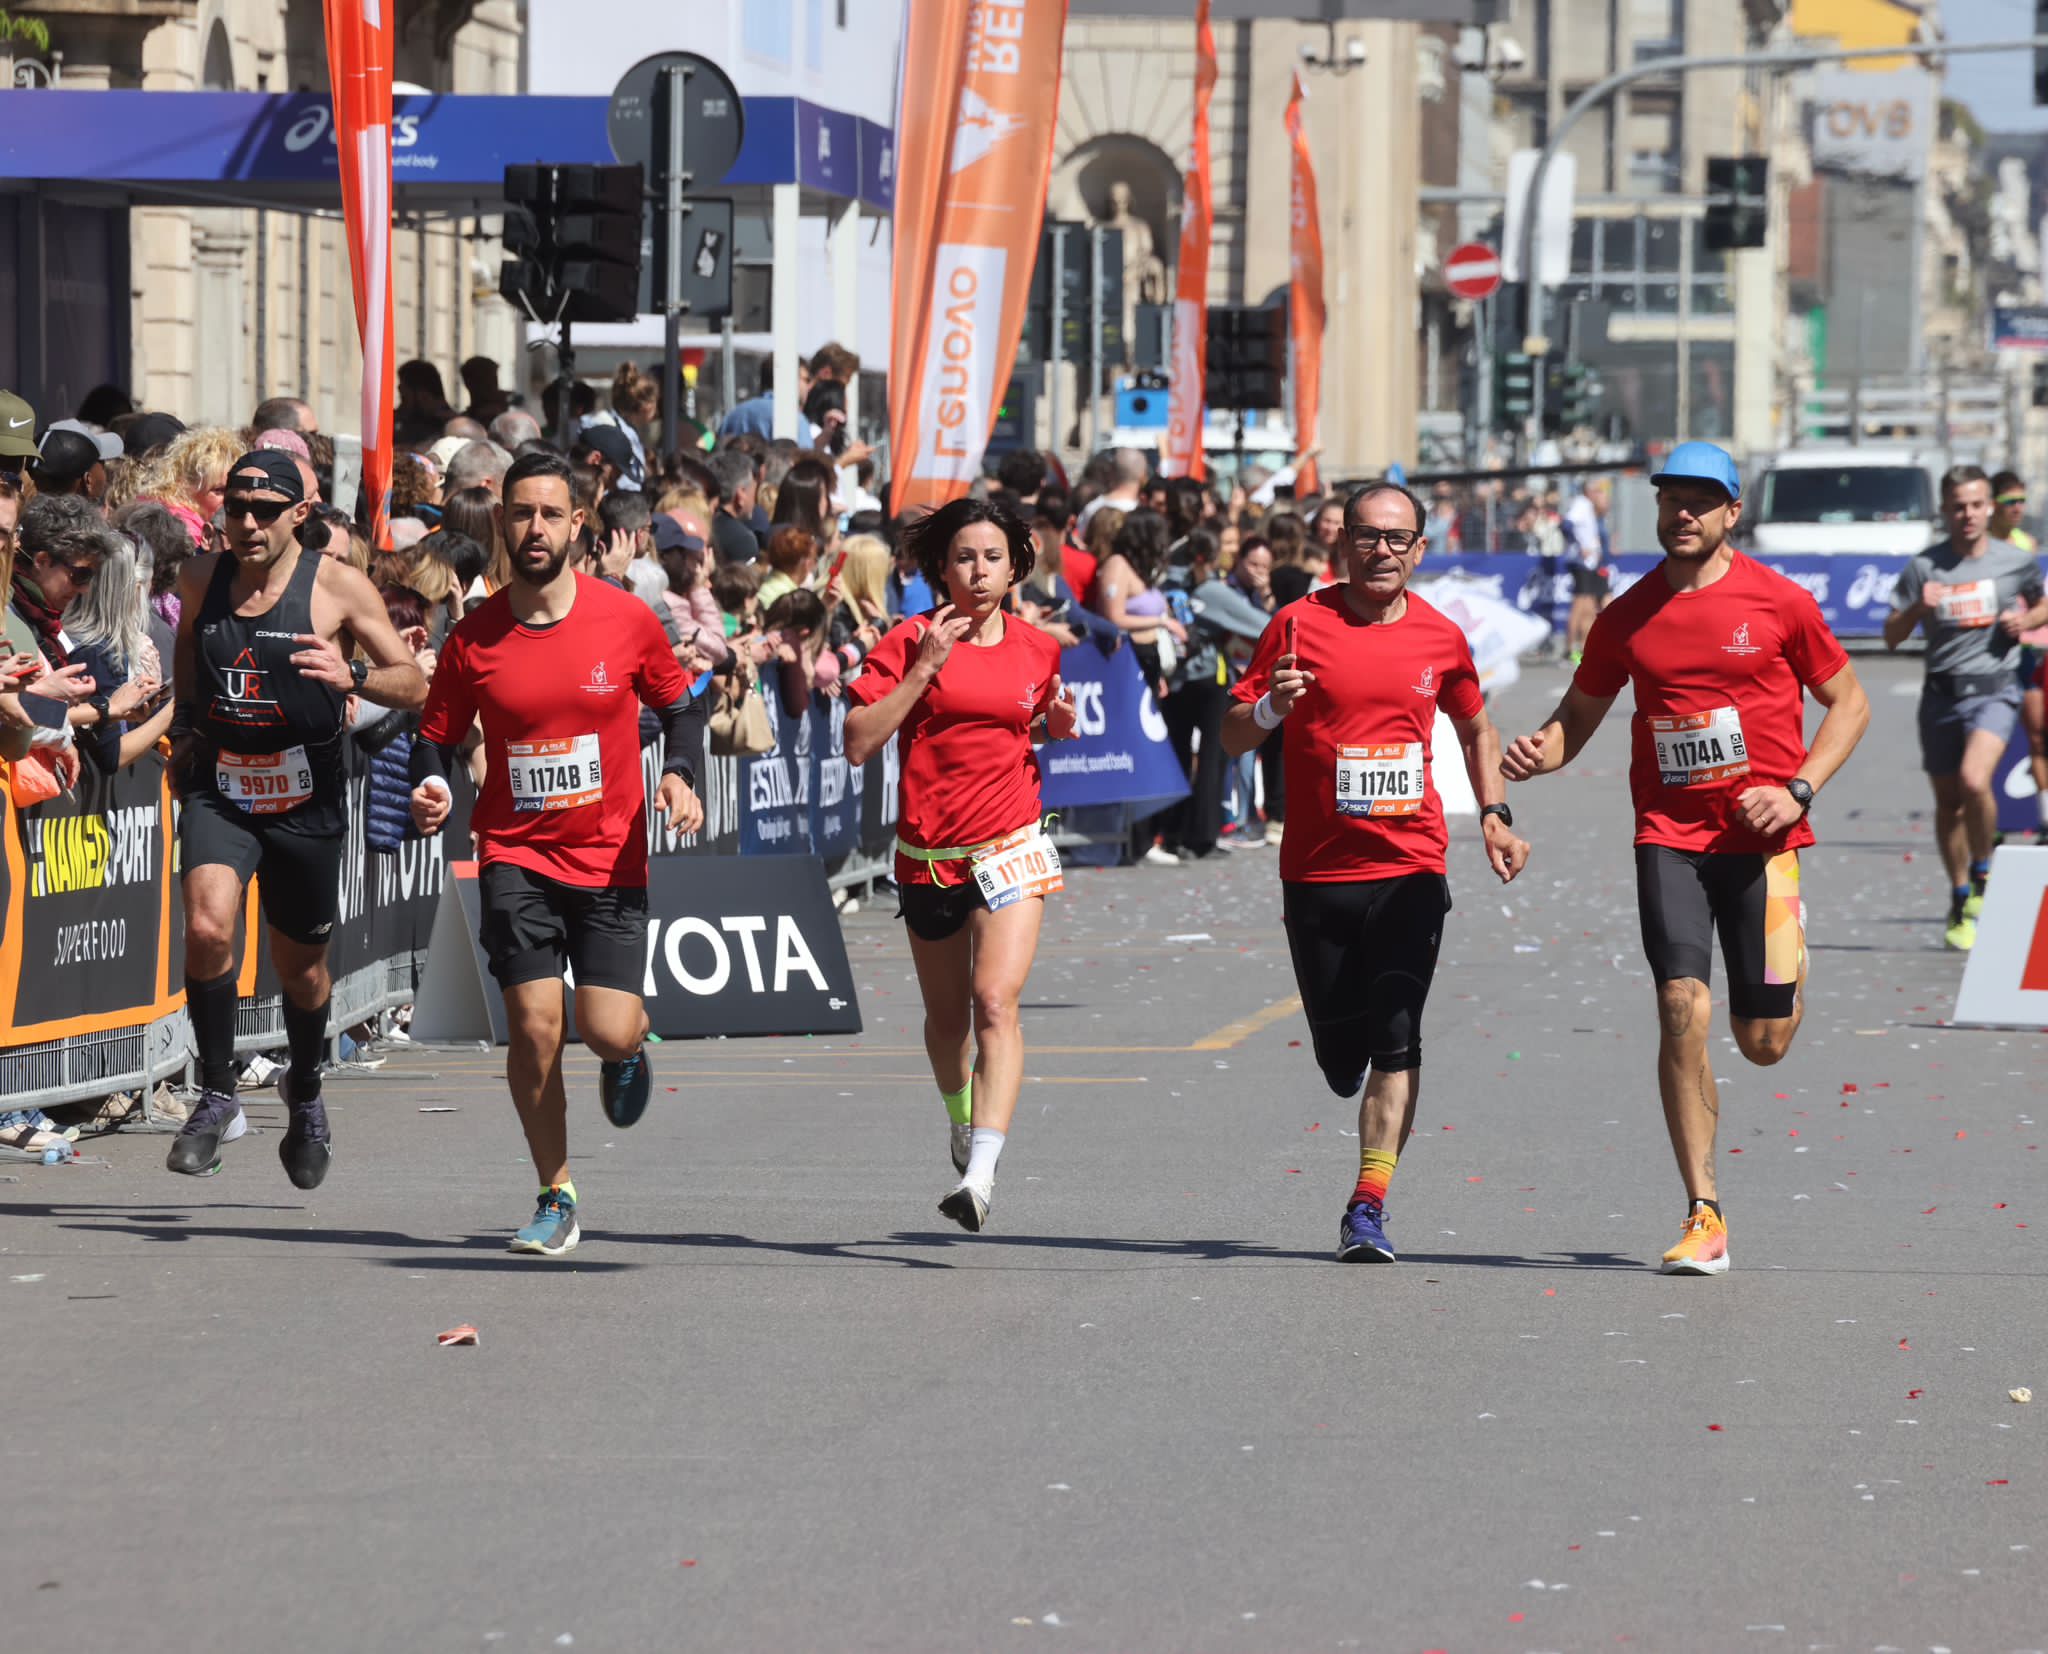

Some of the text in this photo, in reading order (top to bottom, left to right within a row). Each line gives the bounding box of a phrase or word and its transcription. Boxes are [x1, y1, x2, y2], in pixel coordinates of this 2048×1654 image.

[227, 672, 261, 699] UR
[1672, 738, 1724, 767] 1174A
[529, 765, 581, 792] 1174B
[1360, 770, 1408, 796] 1174C
[54, 918, 126, 967] SUPERFOOD
[643, 914, 830, 997] YOTA
